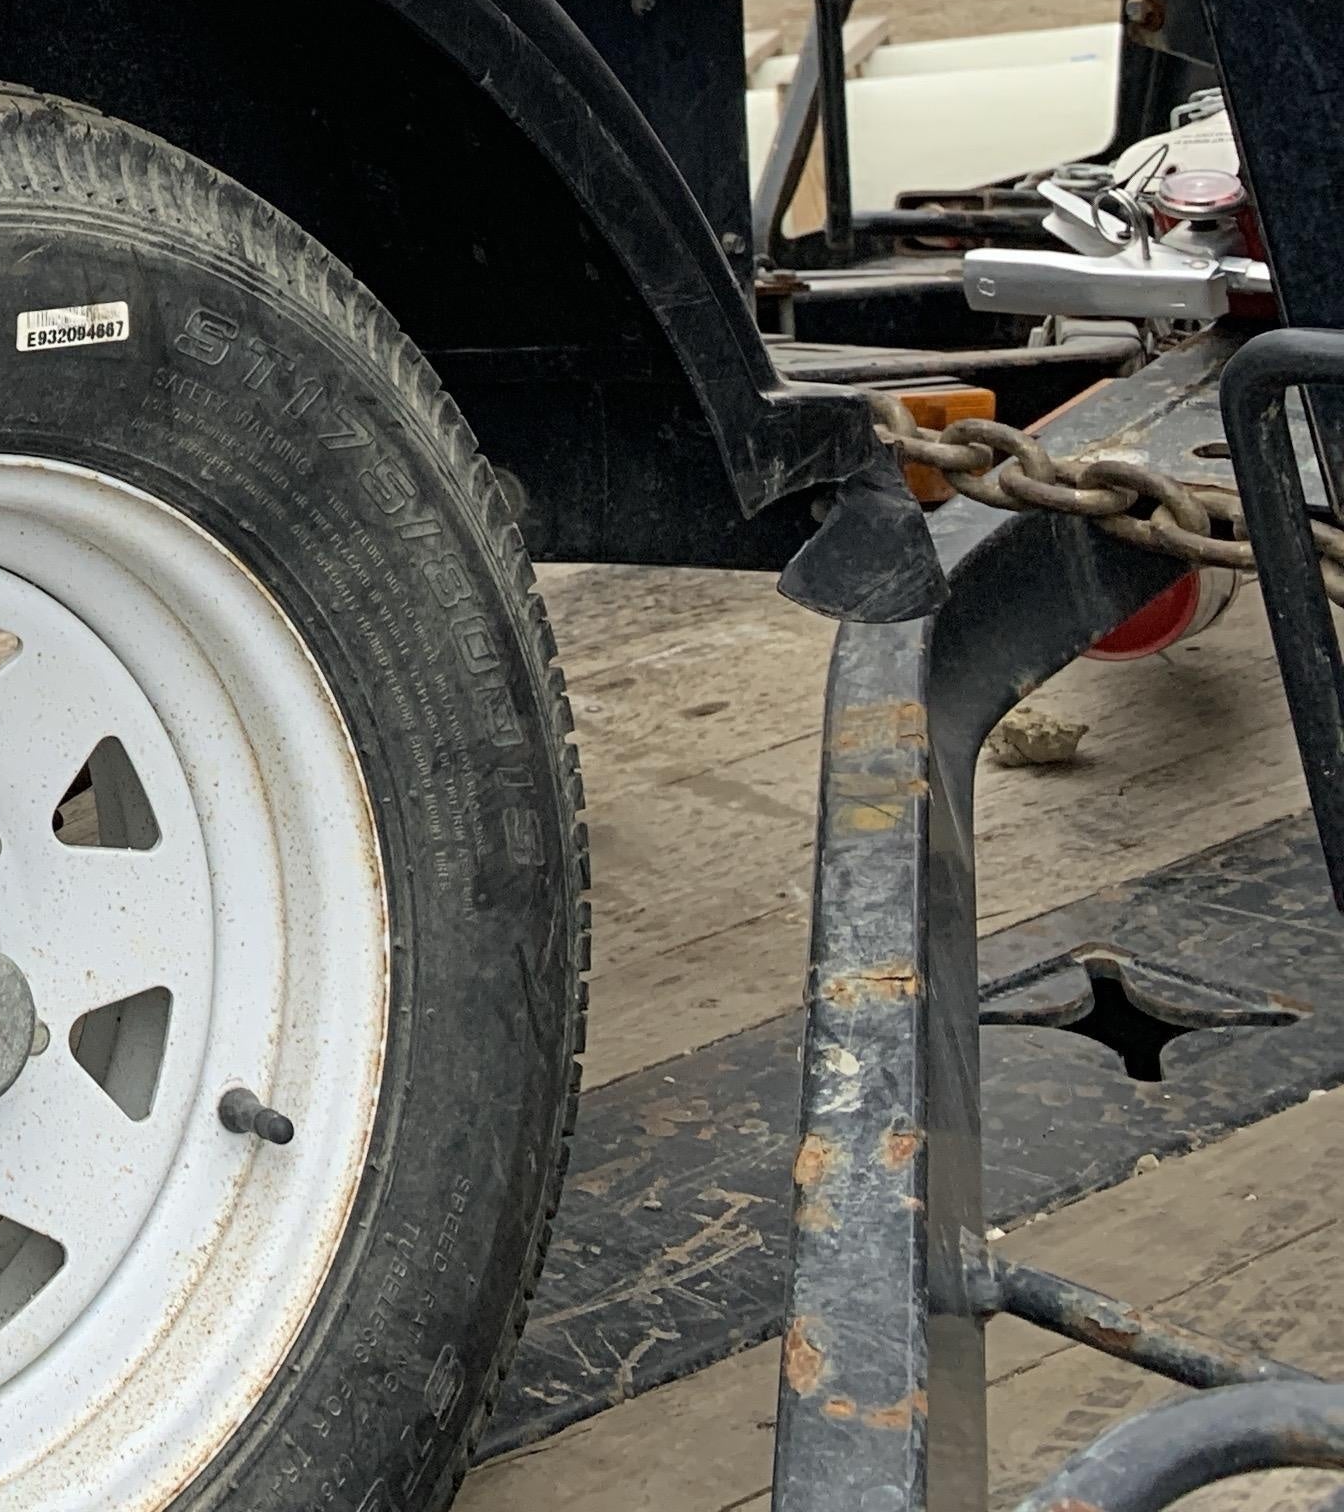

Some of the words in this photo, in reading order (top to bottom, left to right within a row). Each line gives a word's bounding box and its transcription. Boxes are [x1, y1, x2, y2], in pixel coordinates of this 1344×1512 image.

[233, 403, 315, 476] WARNING
[428, 1173, 474, 1275] SPEED
[352, 1222, 421, 1365] TUBELESS
[383, 1287, 438, 1395] RATING
[311, 1374, 354, 1439] FOR
